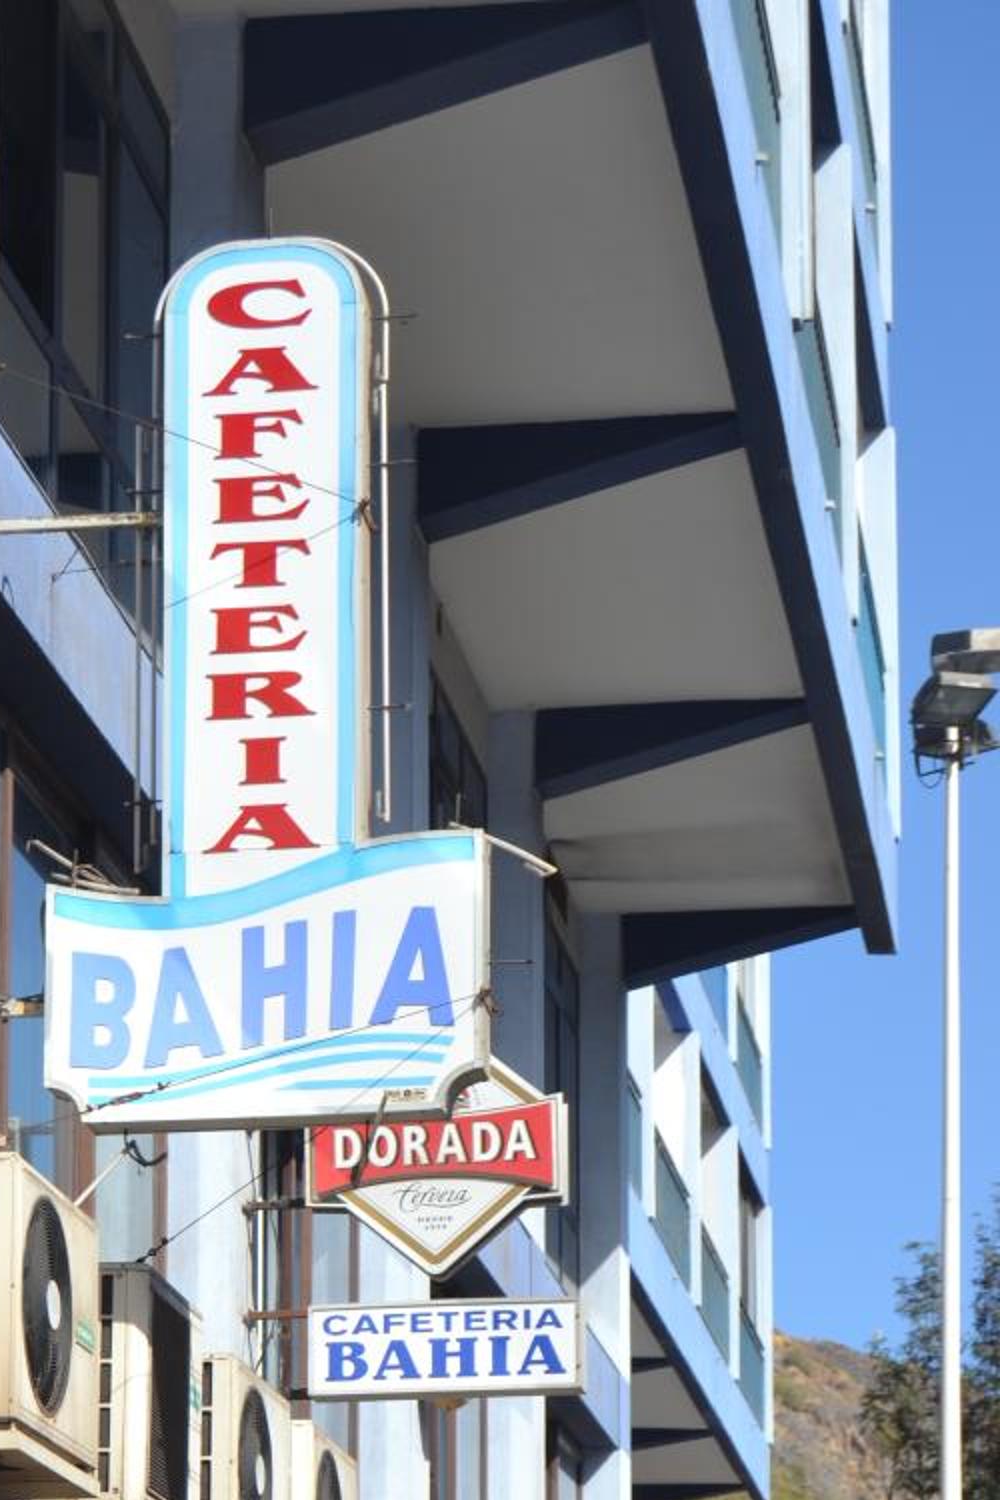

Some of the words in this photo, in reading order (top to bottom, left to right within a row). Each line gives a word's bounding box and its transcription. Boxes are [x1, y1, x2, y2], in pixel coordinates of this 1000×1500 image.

[202, 276, 320, 855] CAFETERIA
[68, 904, 455, 1071] BAHIA
[332, 1119, 536, 1170] DORADA
[321, 1308, 563, 1337] CAFETERIA
[324, 1333, 567, 1383] BAHIA
